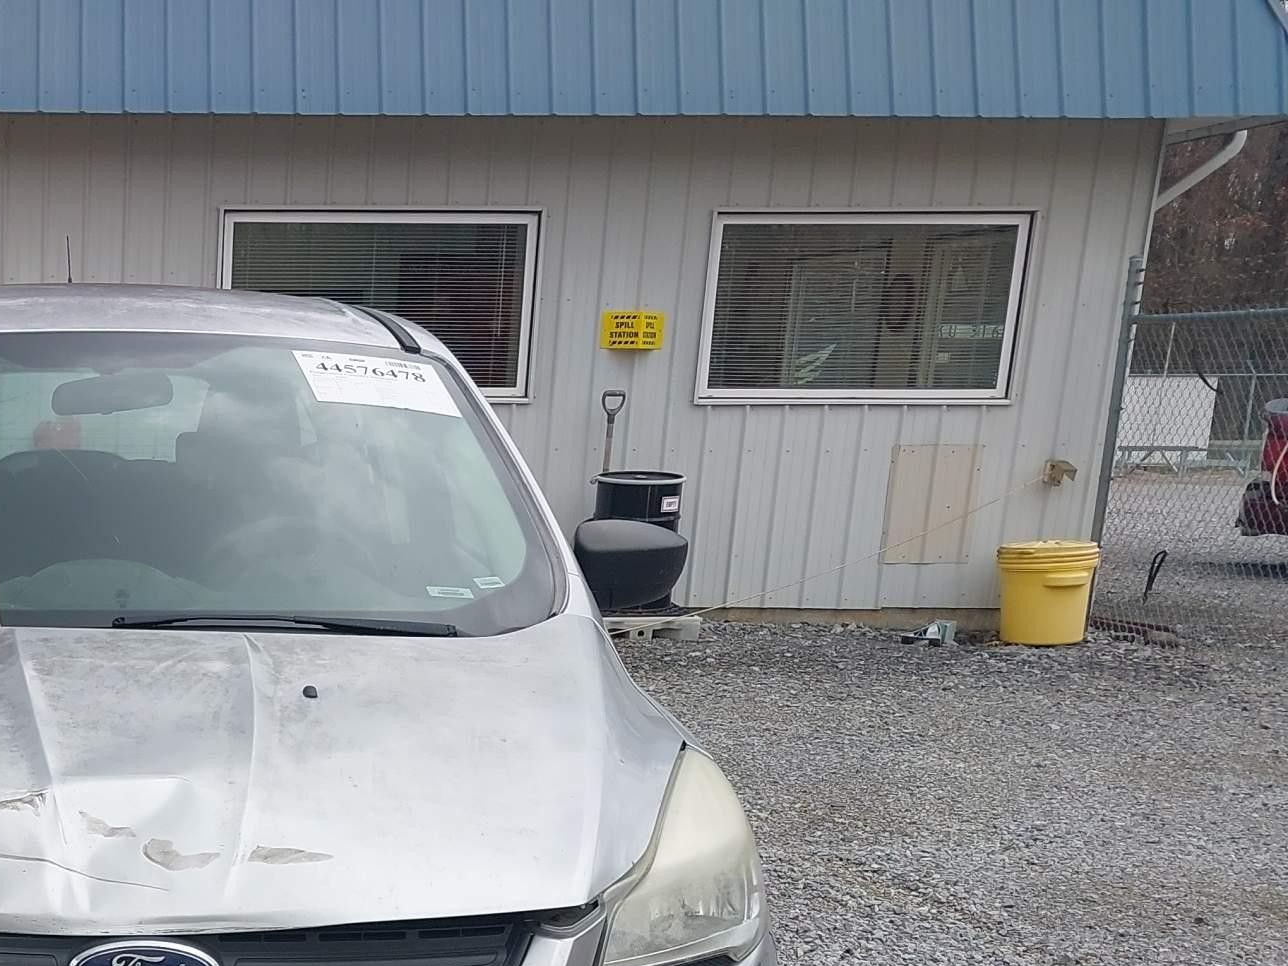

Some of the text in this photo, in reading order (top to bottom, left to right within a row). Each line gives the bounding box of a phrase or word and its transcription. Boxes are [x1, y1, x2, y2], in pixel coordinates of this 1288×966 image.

[615, 321, 634, 329] SPILL
[610, 331, 639, 339] STATION
[315, 362, 426, 383] 44576478
